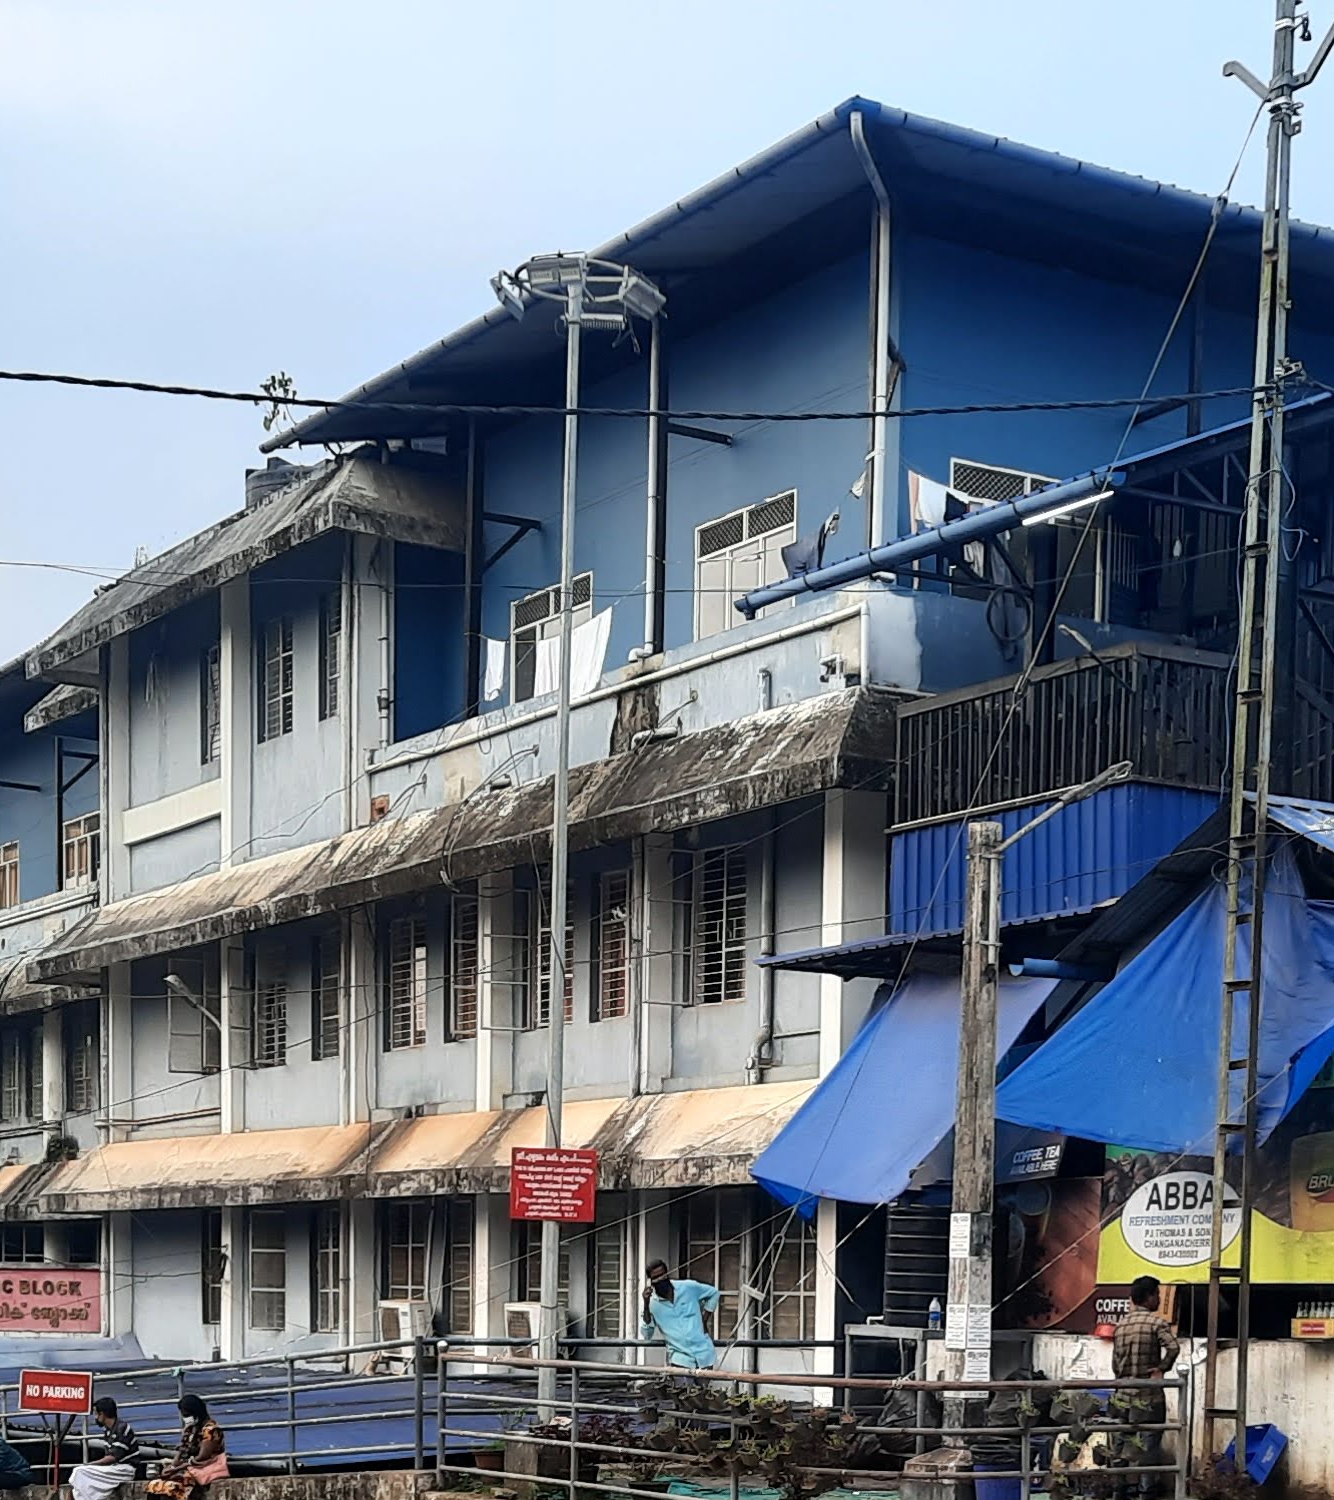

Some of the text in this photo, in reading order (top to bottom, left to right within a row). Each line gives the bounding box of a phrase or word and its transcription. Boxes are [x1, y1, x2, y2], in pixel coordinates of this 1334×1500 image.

[1045, 1145, 1061, 1159] TEA
[1145, 1180, 1214, 1211] ABBA
[1129, 1213, 1236, 1227] REFRESHMENT COMNY
[1155, 1228, 1186, 1238] THOMAS
[19, 1279, 82, 1297] BLOCK
[1095, 1298, 1130, 1313] COFFE
[26, 1384, 85, 1399] NO PARKING
